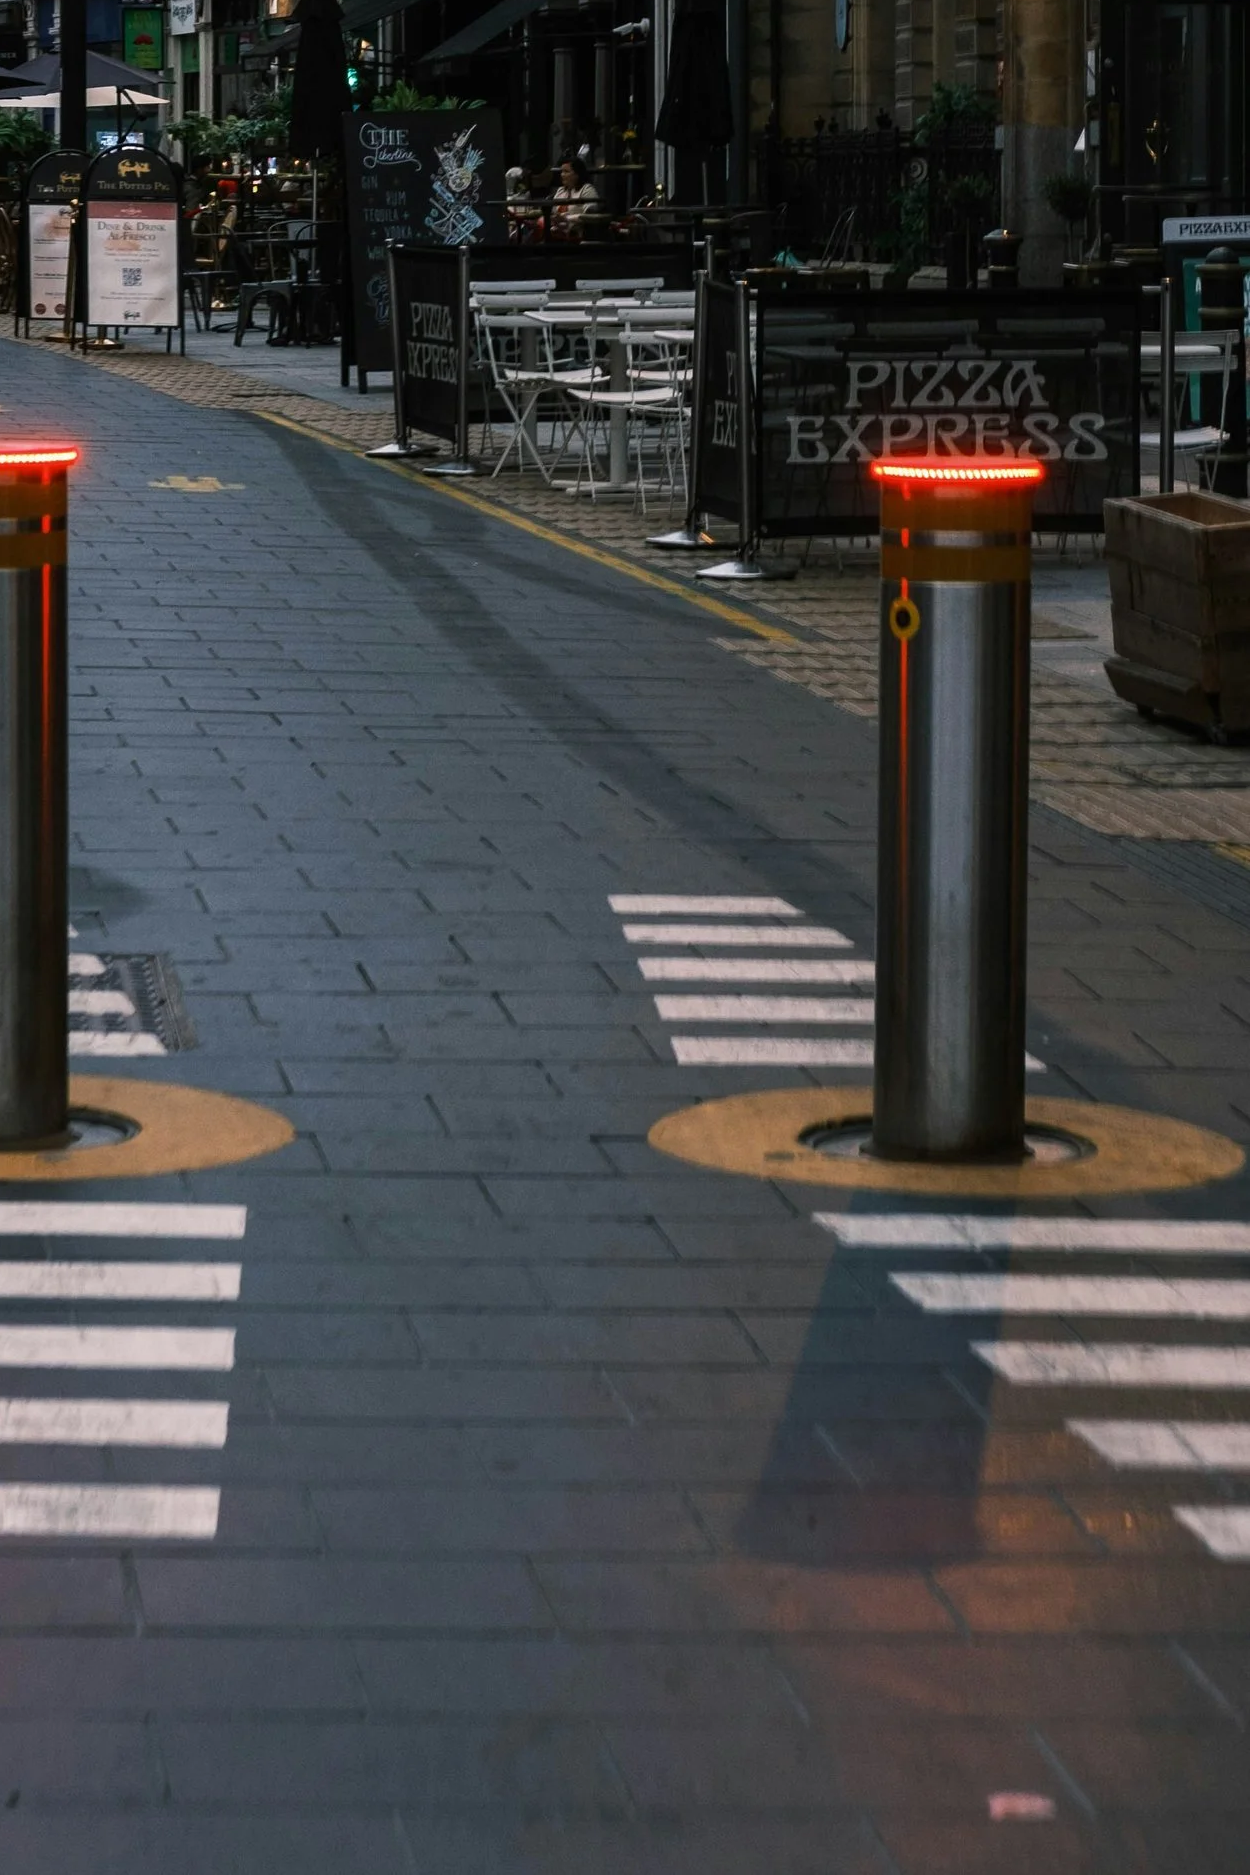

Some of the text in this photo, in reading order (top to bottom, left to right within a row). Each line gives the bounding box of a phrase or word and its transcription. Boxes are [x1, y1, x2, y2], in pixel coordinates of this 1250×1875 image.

[386, 190, 406, 206] RUM
[410, 302, 455, 343] PIZZA
[845, 358, 1050, 408] PIZZA
[786, 411, 1109, 465] EXPRESS
